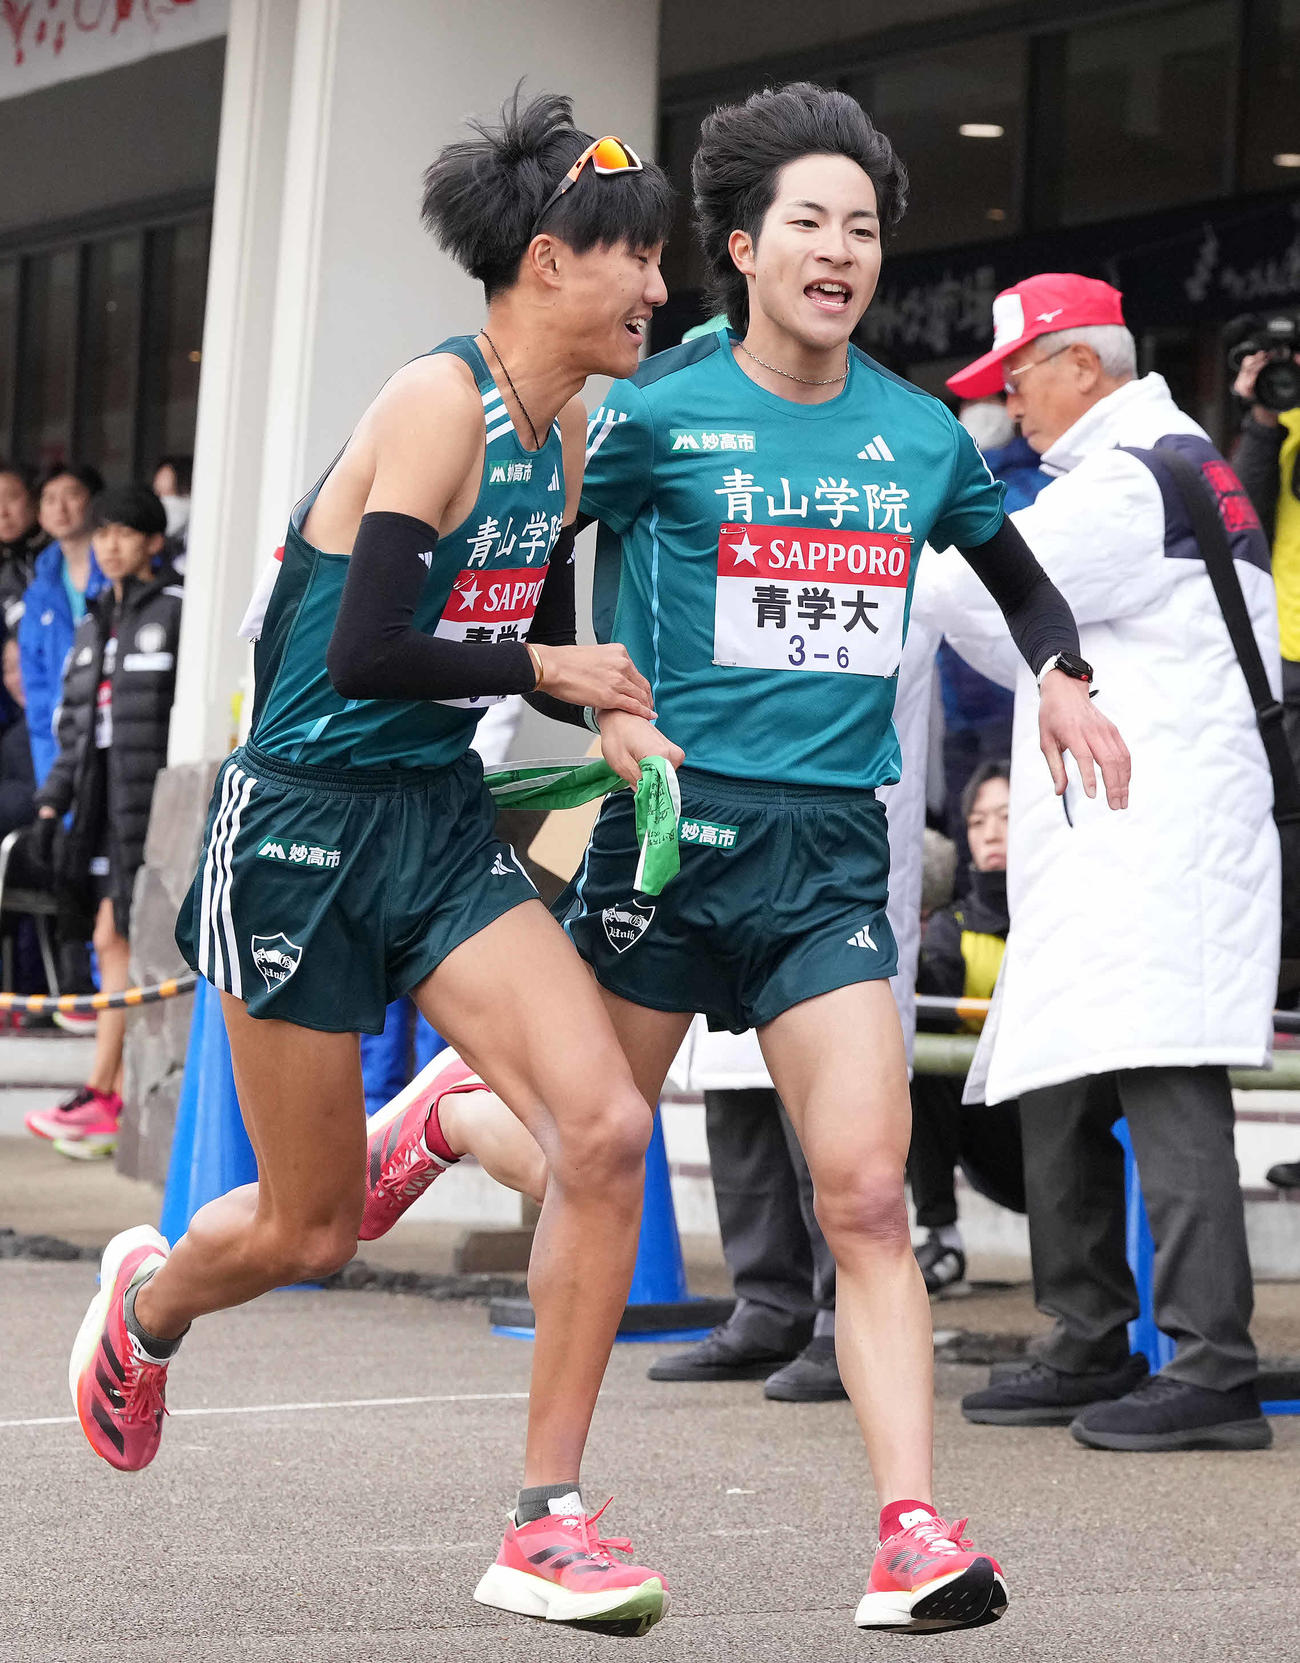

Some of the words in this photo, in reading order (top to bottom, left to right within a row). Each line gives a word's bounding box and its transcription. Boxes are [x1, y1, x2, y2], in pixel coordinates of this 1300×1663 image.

[701, 432, 755, 450] 妙高市
[507, 462, 533, 482] 妙高市
[714, 467, 913, 534] 青山学院
[767, 539, 906, 577] SAPPORO
[751, 584, 880, 635] 青学大
[680, 821, 737, 848] 妙高市
[287, 843, 342, 868] 妙高市
